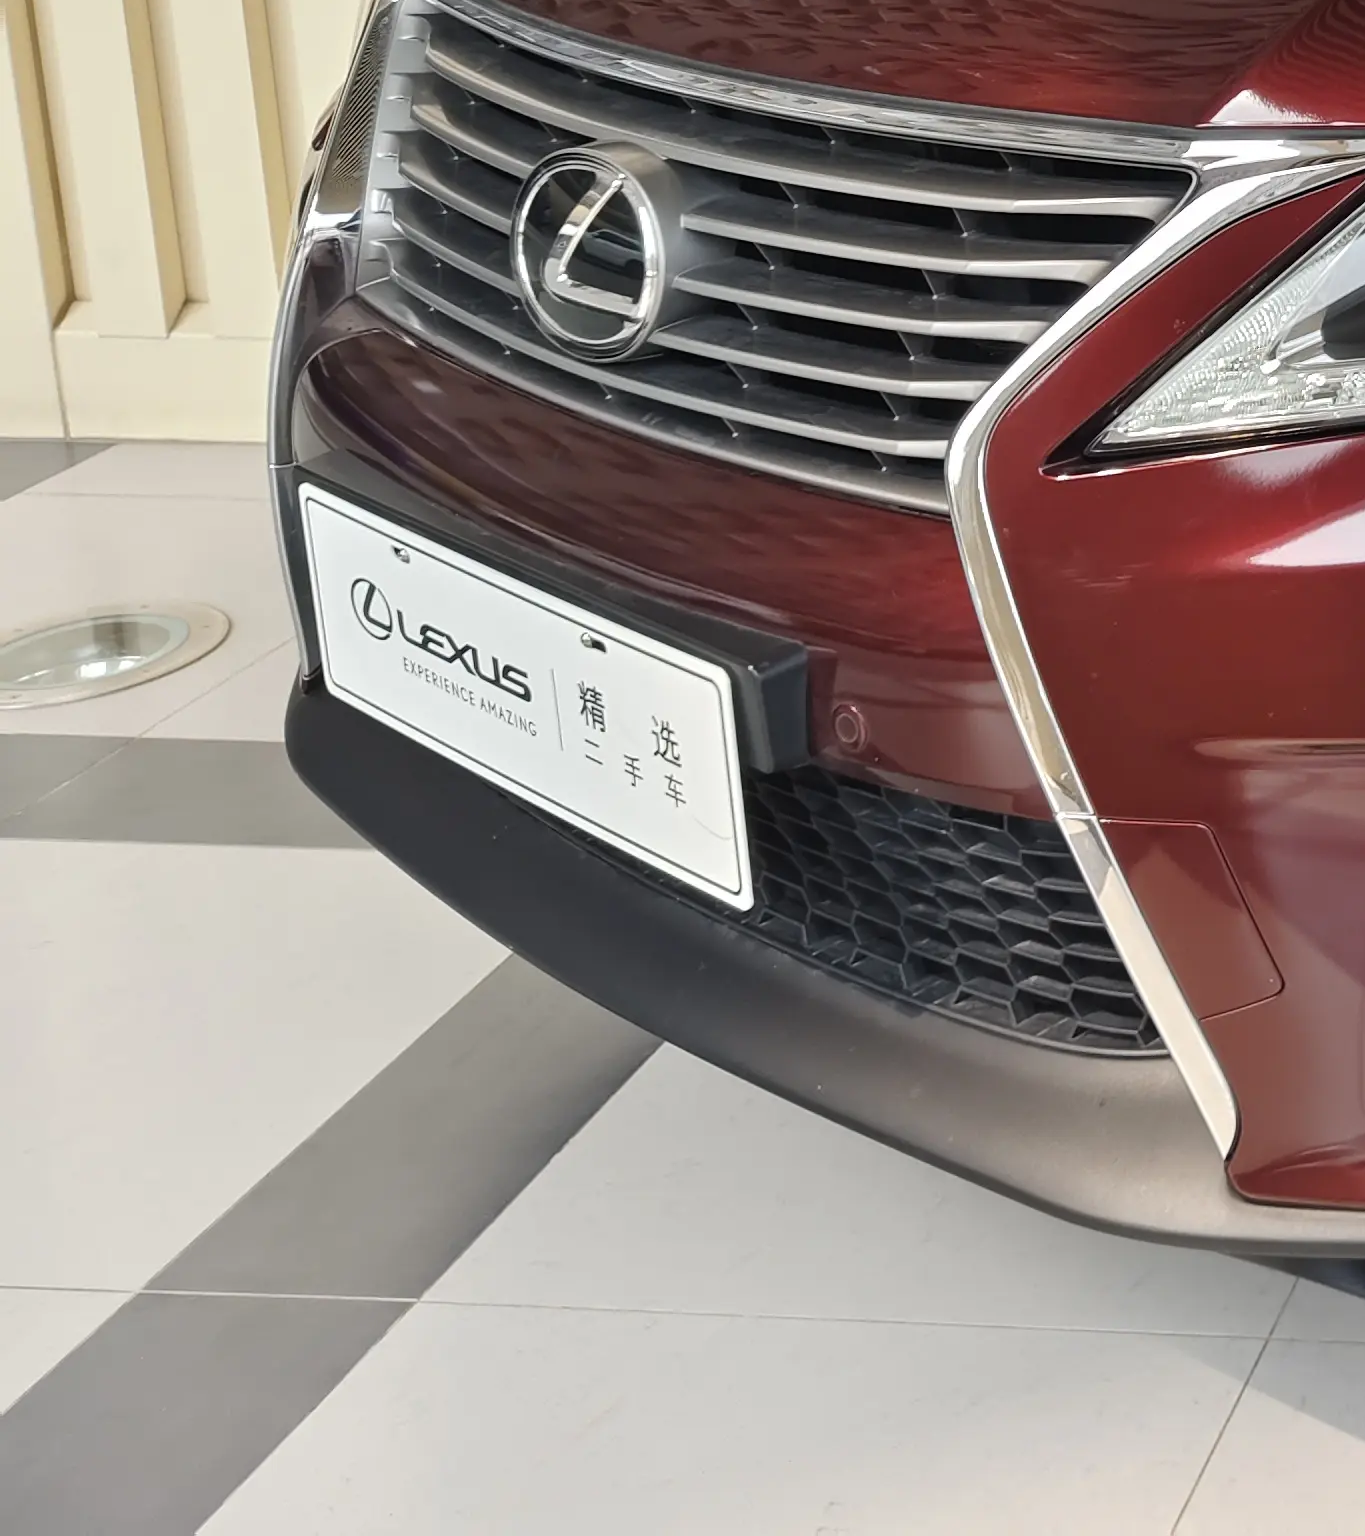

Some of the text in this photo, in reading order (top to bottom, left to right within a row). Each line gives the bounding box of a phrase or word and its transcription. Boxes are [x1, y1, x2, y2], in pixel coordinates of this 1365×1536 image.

[397, 608, 532, 703] LEXUS
[403, 657, 538, 737] EXPERIENCE AMAZING
